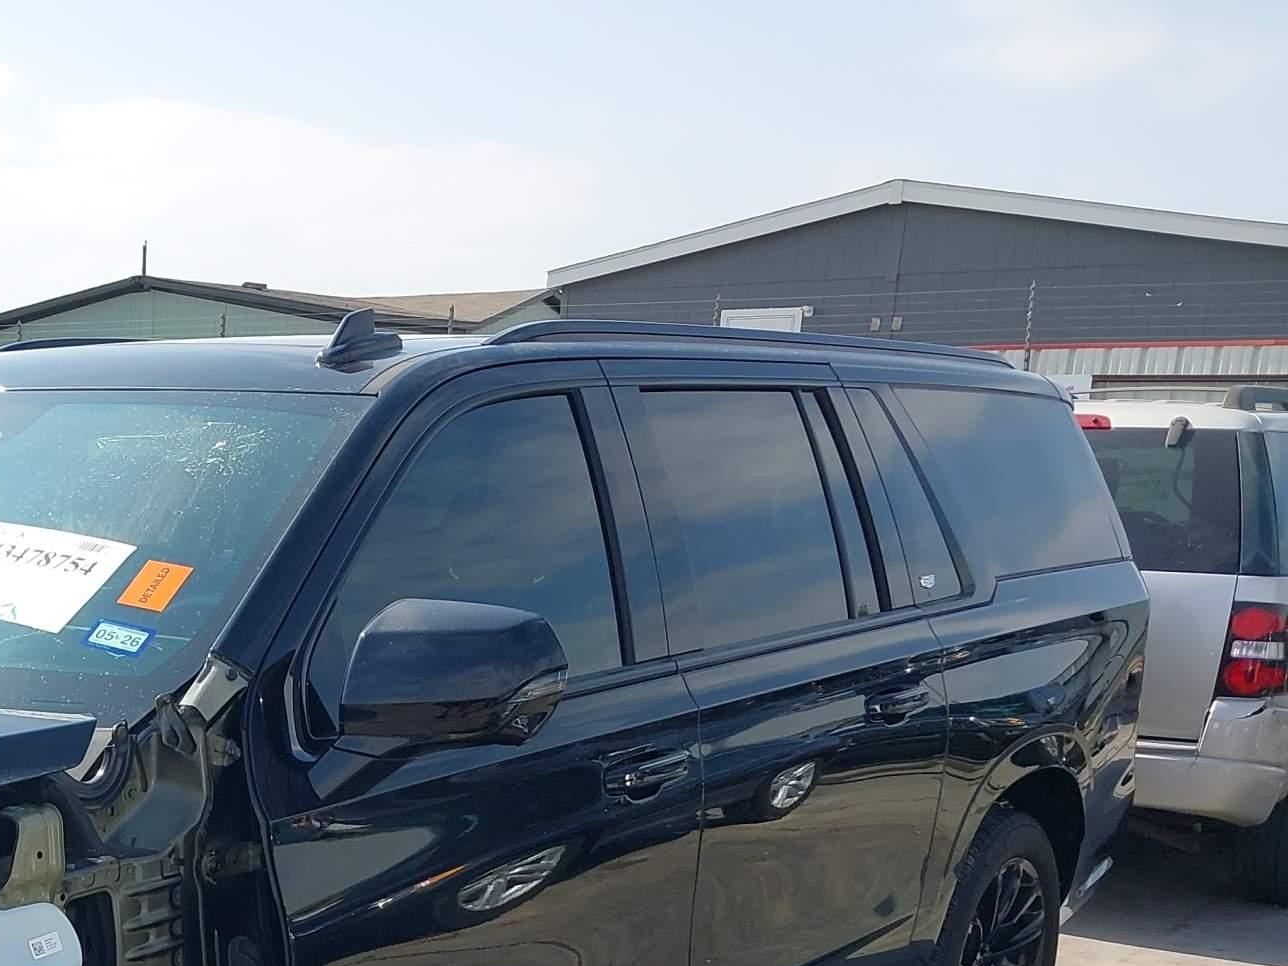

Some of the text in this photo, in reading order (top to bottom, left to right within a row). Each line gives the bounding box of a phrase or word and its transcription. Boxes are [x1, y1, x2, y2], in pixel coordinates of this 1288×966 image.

[138, 567, 171, 604] DETAILED
[95, 628, 117, 641] 05
[119, 634, 142, 647] 26
